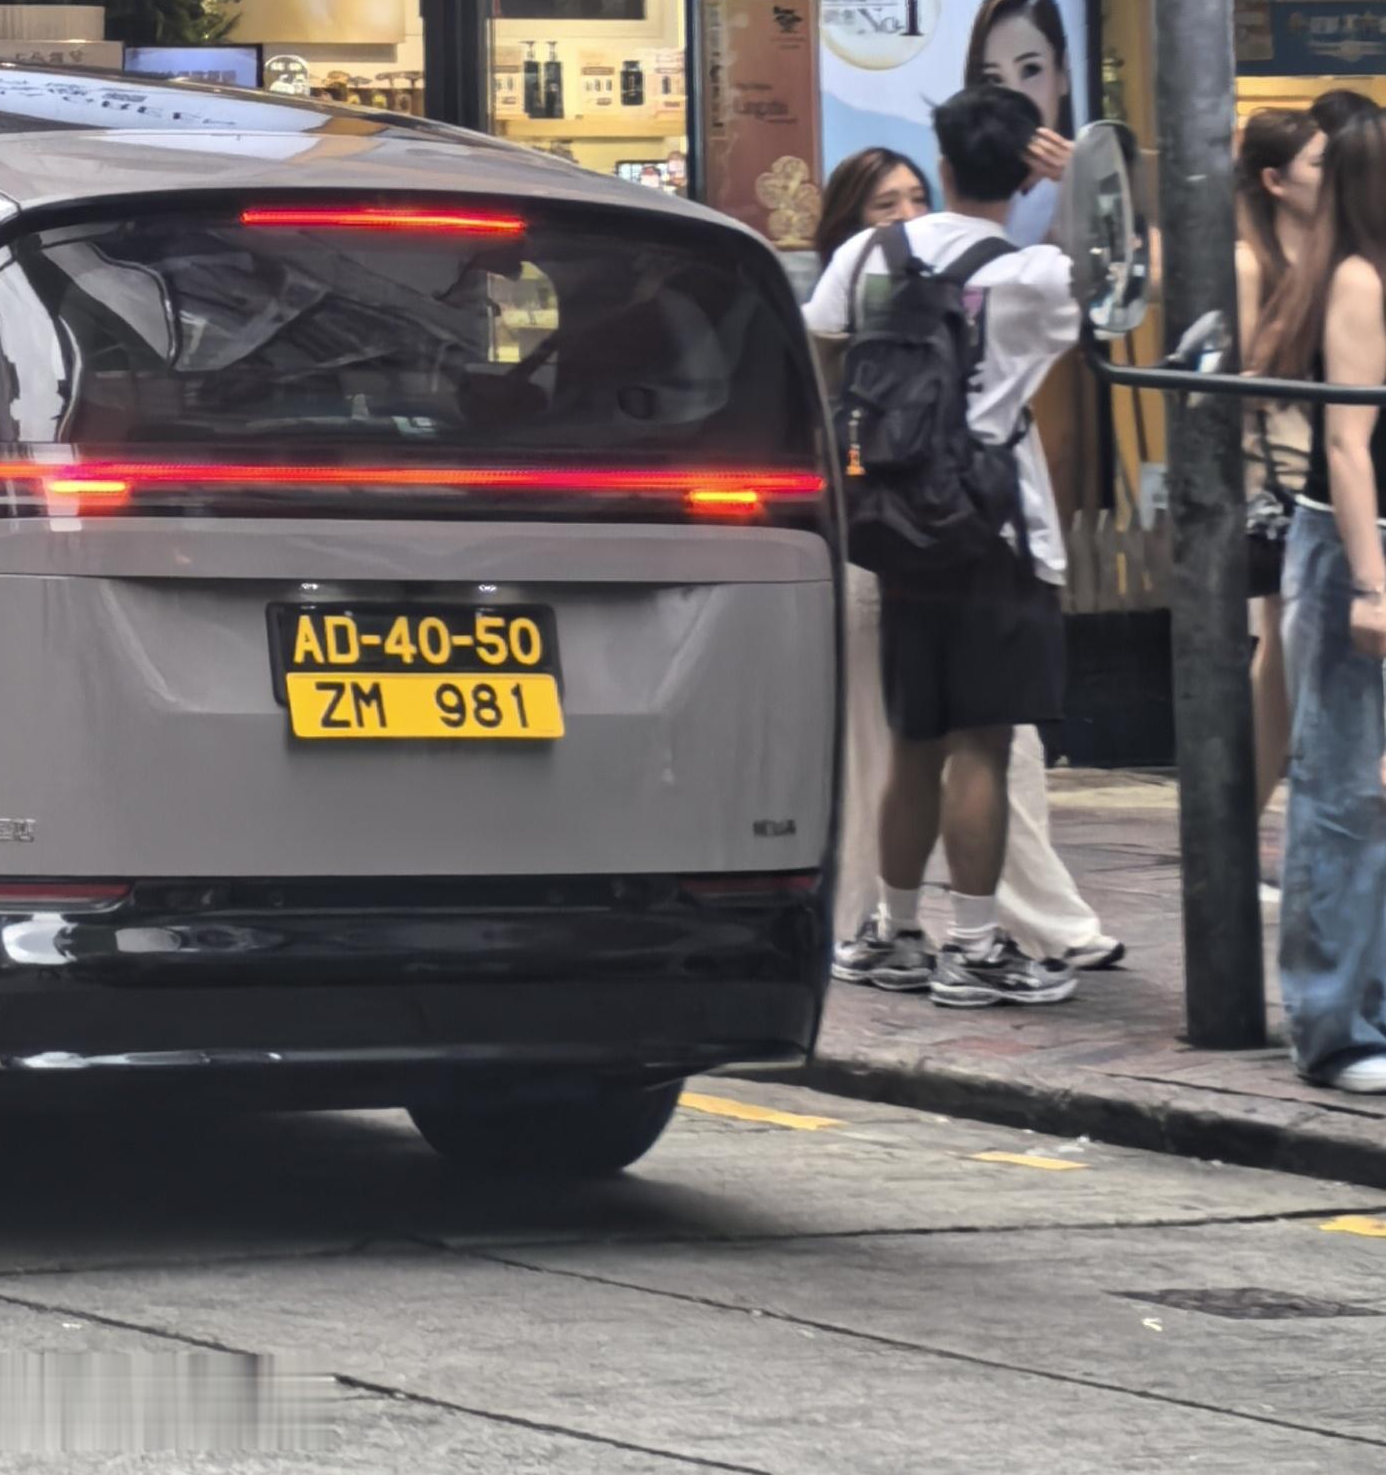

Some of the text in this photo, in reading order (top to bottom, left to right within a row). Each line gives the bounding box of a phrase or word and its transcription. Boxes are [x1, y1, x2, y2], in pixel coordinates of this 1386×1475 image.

[293, 615, 543, 665] AD-40-50
[315, 682, 530, 729] ZM 981
